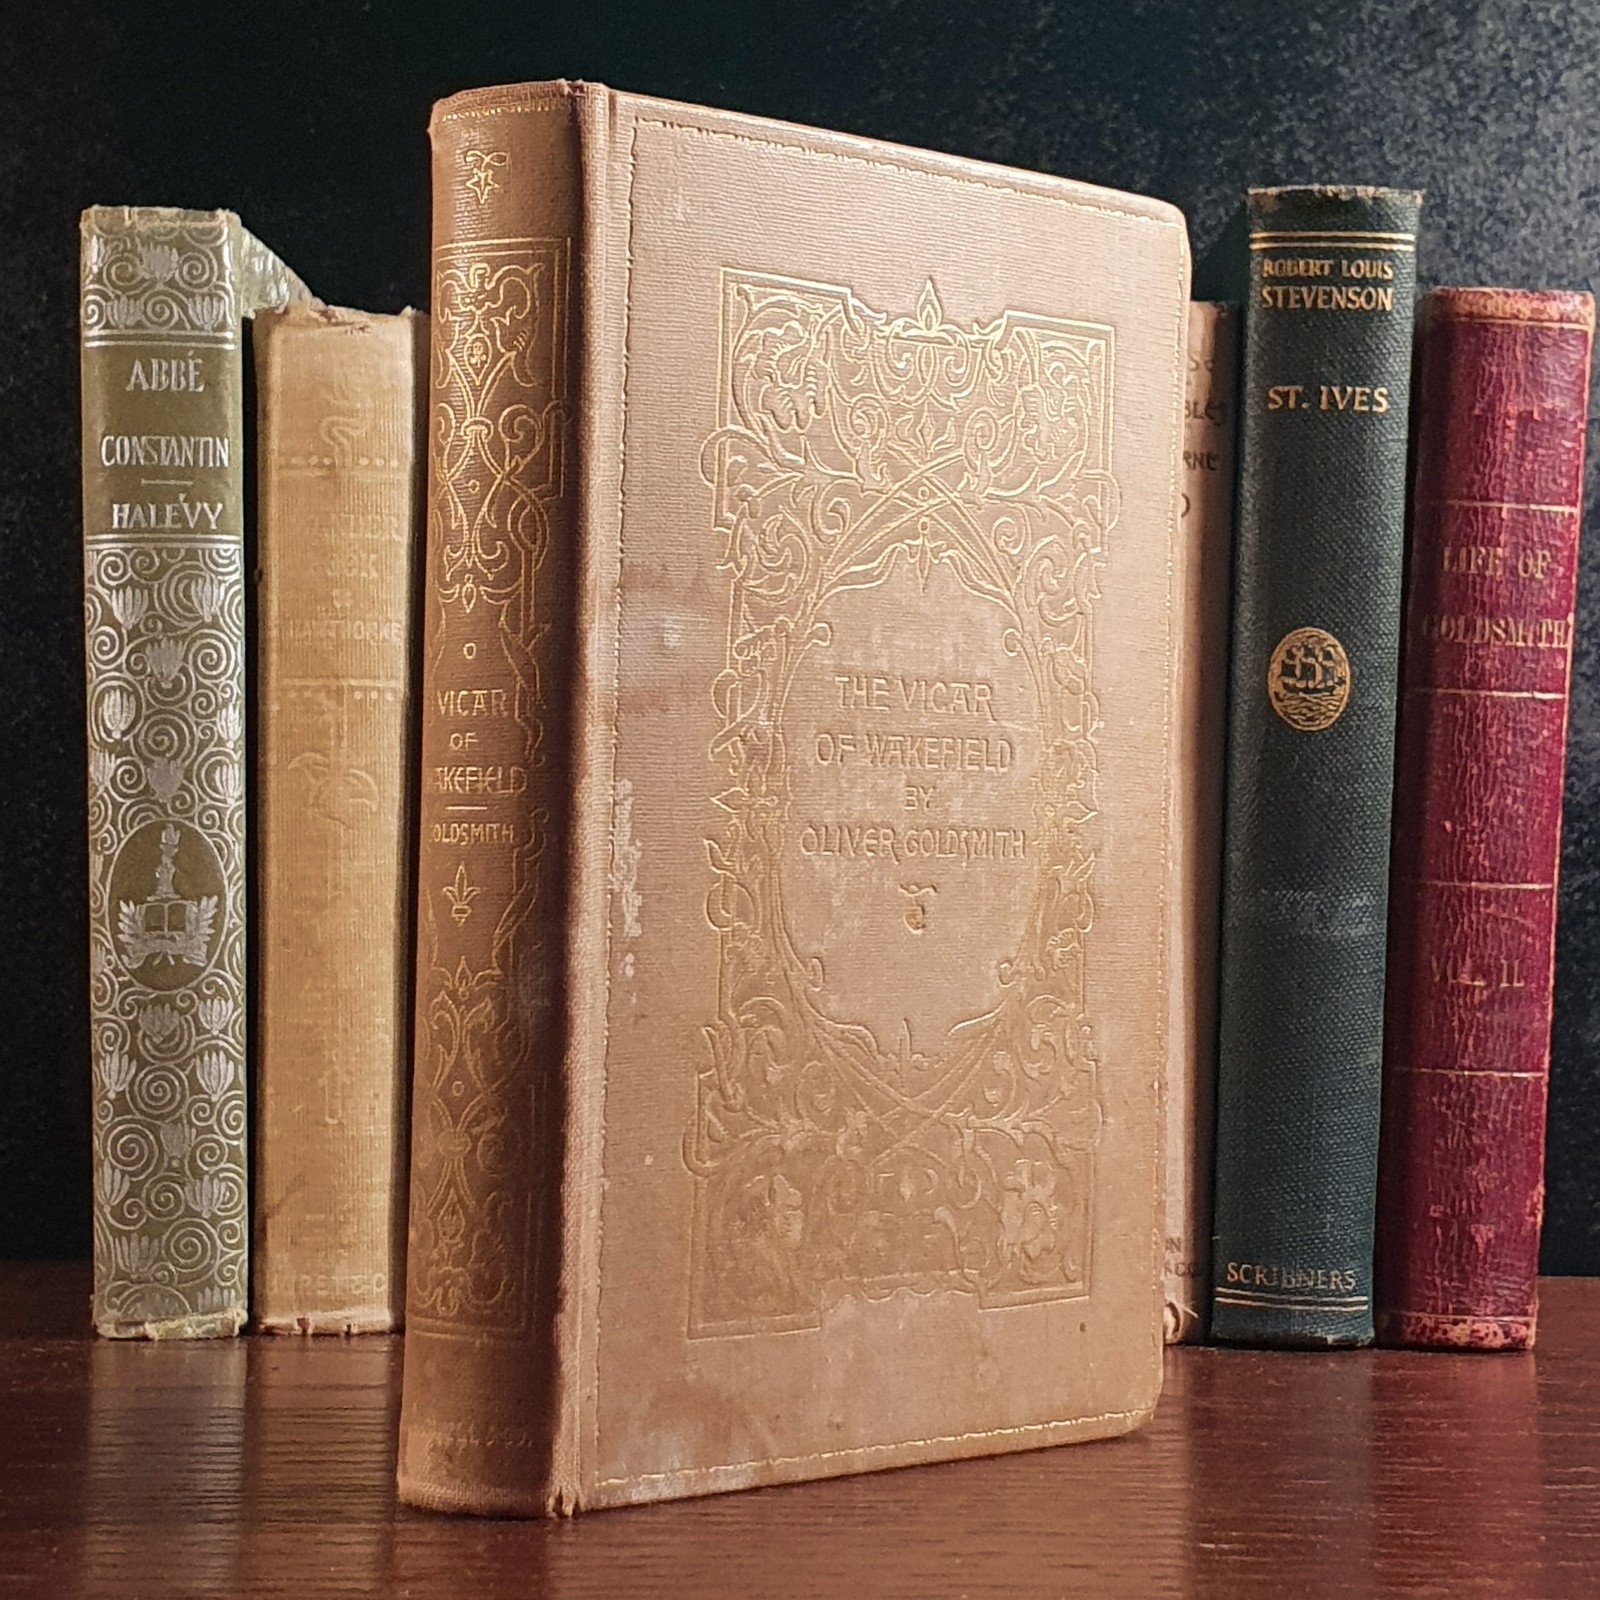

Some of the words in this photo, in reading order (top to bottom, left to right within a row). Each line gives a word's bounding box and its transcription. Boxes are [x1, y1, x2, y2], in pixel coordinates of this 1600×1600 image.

[1341, 259, 1395, 280] LOUIS
[1260, 285, 1394, 312] STEVENSON
[125, 350, 205, 393] ABBÉ
[1267, 385, 1311, 411] ST.
[1320, 385, 1390, 414] IVES
[100, 435, 230, 469] CONSTANTIN
[111, 492, 224, 530] HALÉVY
[1517, 548, 1552, 580] OF
[436, 688, 508, 718] VICAR
[834, 675, 891, 712] THE
[899, 678, 998, 722] VICAR
[448, 732, 480, 751] OF
[816, 731, 857, 767] OF
[864, 733, 1015, 773] WAKEFIELD
[431, 765, 528, 795] AKEFIELD
[902, 784, 937, 812] BY
[429, 821, 514, 846] OLDSMITH
[800, 825, 901, 866] OLIVER
[903, 828, 1027, 867] GOLDSMITH
[1226, 1260, 1358, 1290] SCRIBNERS
